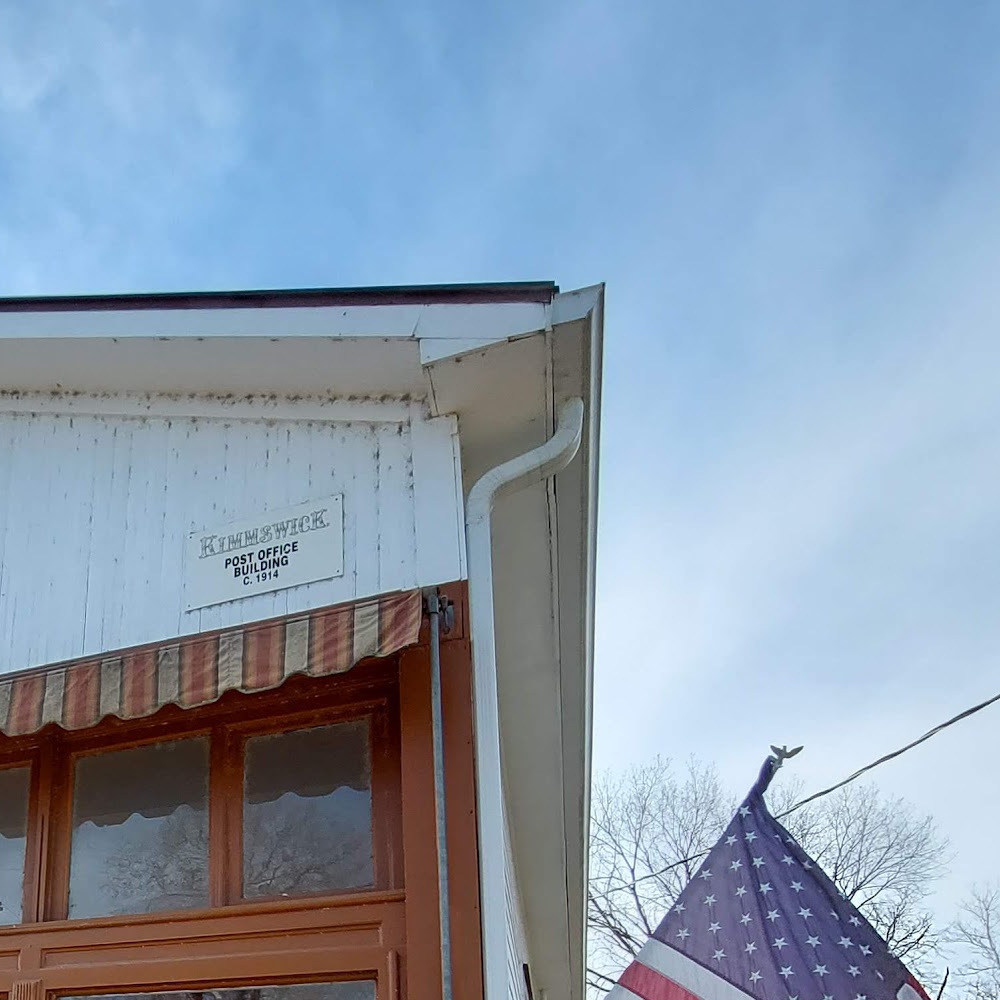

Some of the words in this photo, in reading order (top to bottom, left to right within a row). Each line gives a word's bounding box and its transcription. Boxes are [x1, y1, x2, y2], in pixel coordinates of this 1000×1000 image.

[224, 552, 254, 569] POST
[257, 541, 299, 561] OFFICE
[233, 555, 289, 578] BUILDING
[256, 569, 279, 583] 1914
